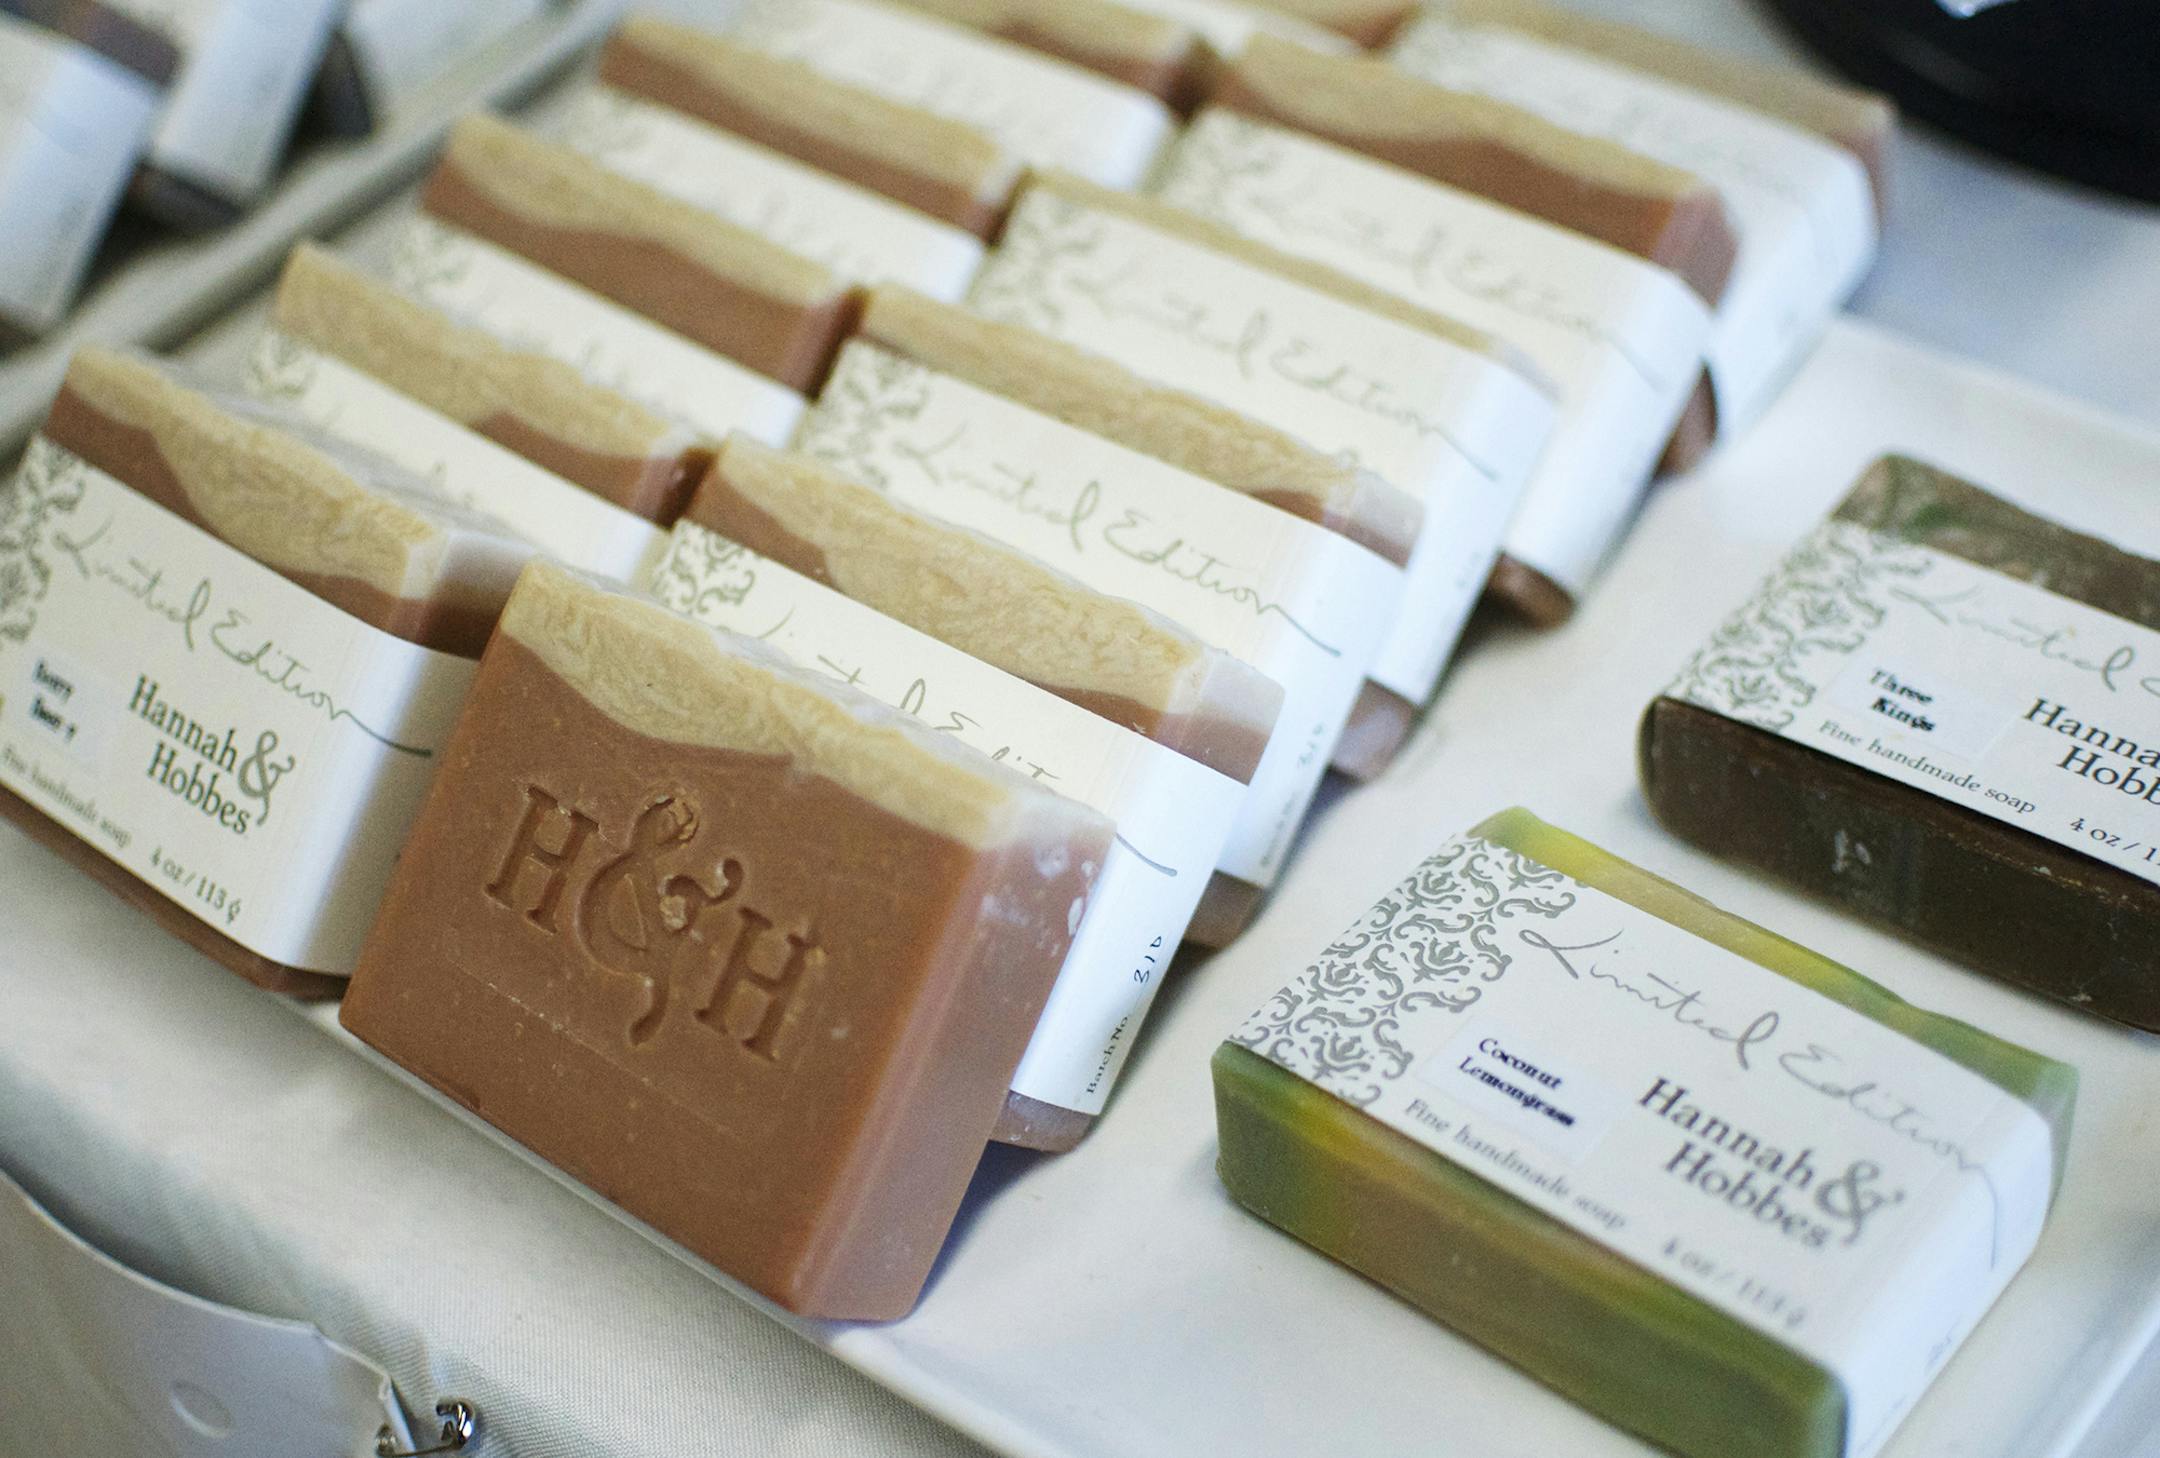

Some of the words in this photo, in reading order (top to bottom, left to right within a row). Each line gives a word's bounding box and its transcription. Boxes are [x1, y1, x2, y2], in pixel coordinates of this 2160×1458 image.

[1104, 508, 1341, 658] Edition
[51, 513, 211, 652] Limited
[209, 607, 433, 759] Edition
[1868, 667, 1934, 704] Three
[1869, 696, 1938, 733] Kings
[127, 671, 238, 774] Hannah
[236, 728, 297, 828] &
[146, 741, 251, 835] Hobbes
[1818, 720, 1862, 747] Fine
[1867, 738, 1981, 793] handmade
[1984, 783, 2036, 816] soap
[2068, 817, 2086, 833] 4
[2090, 827, 2122, 848] oz
[2143, 846, 2160, 867] 1
[197, 876, 228, 910] 113
[1086, 1045, 1116, 1094] Batch
[1477, 1037, 1563, 1091] Coconut
[1518, 927, 1780, 1071] Limited
[1778, 1042, 1999, 1271] Edition
[1403, 1097, 1450, 1133] Fine
[1453, 1124, 1571, 1198] handmade
[1636, 1076, 1817, 1192] Hannah
[1814, 1159, 1906, 1246] &
[1664, 1140, 1831, 1250] Hobbes
